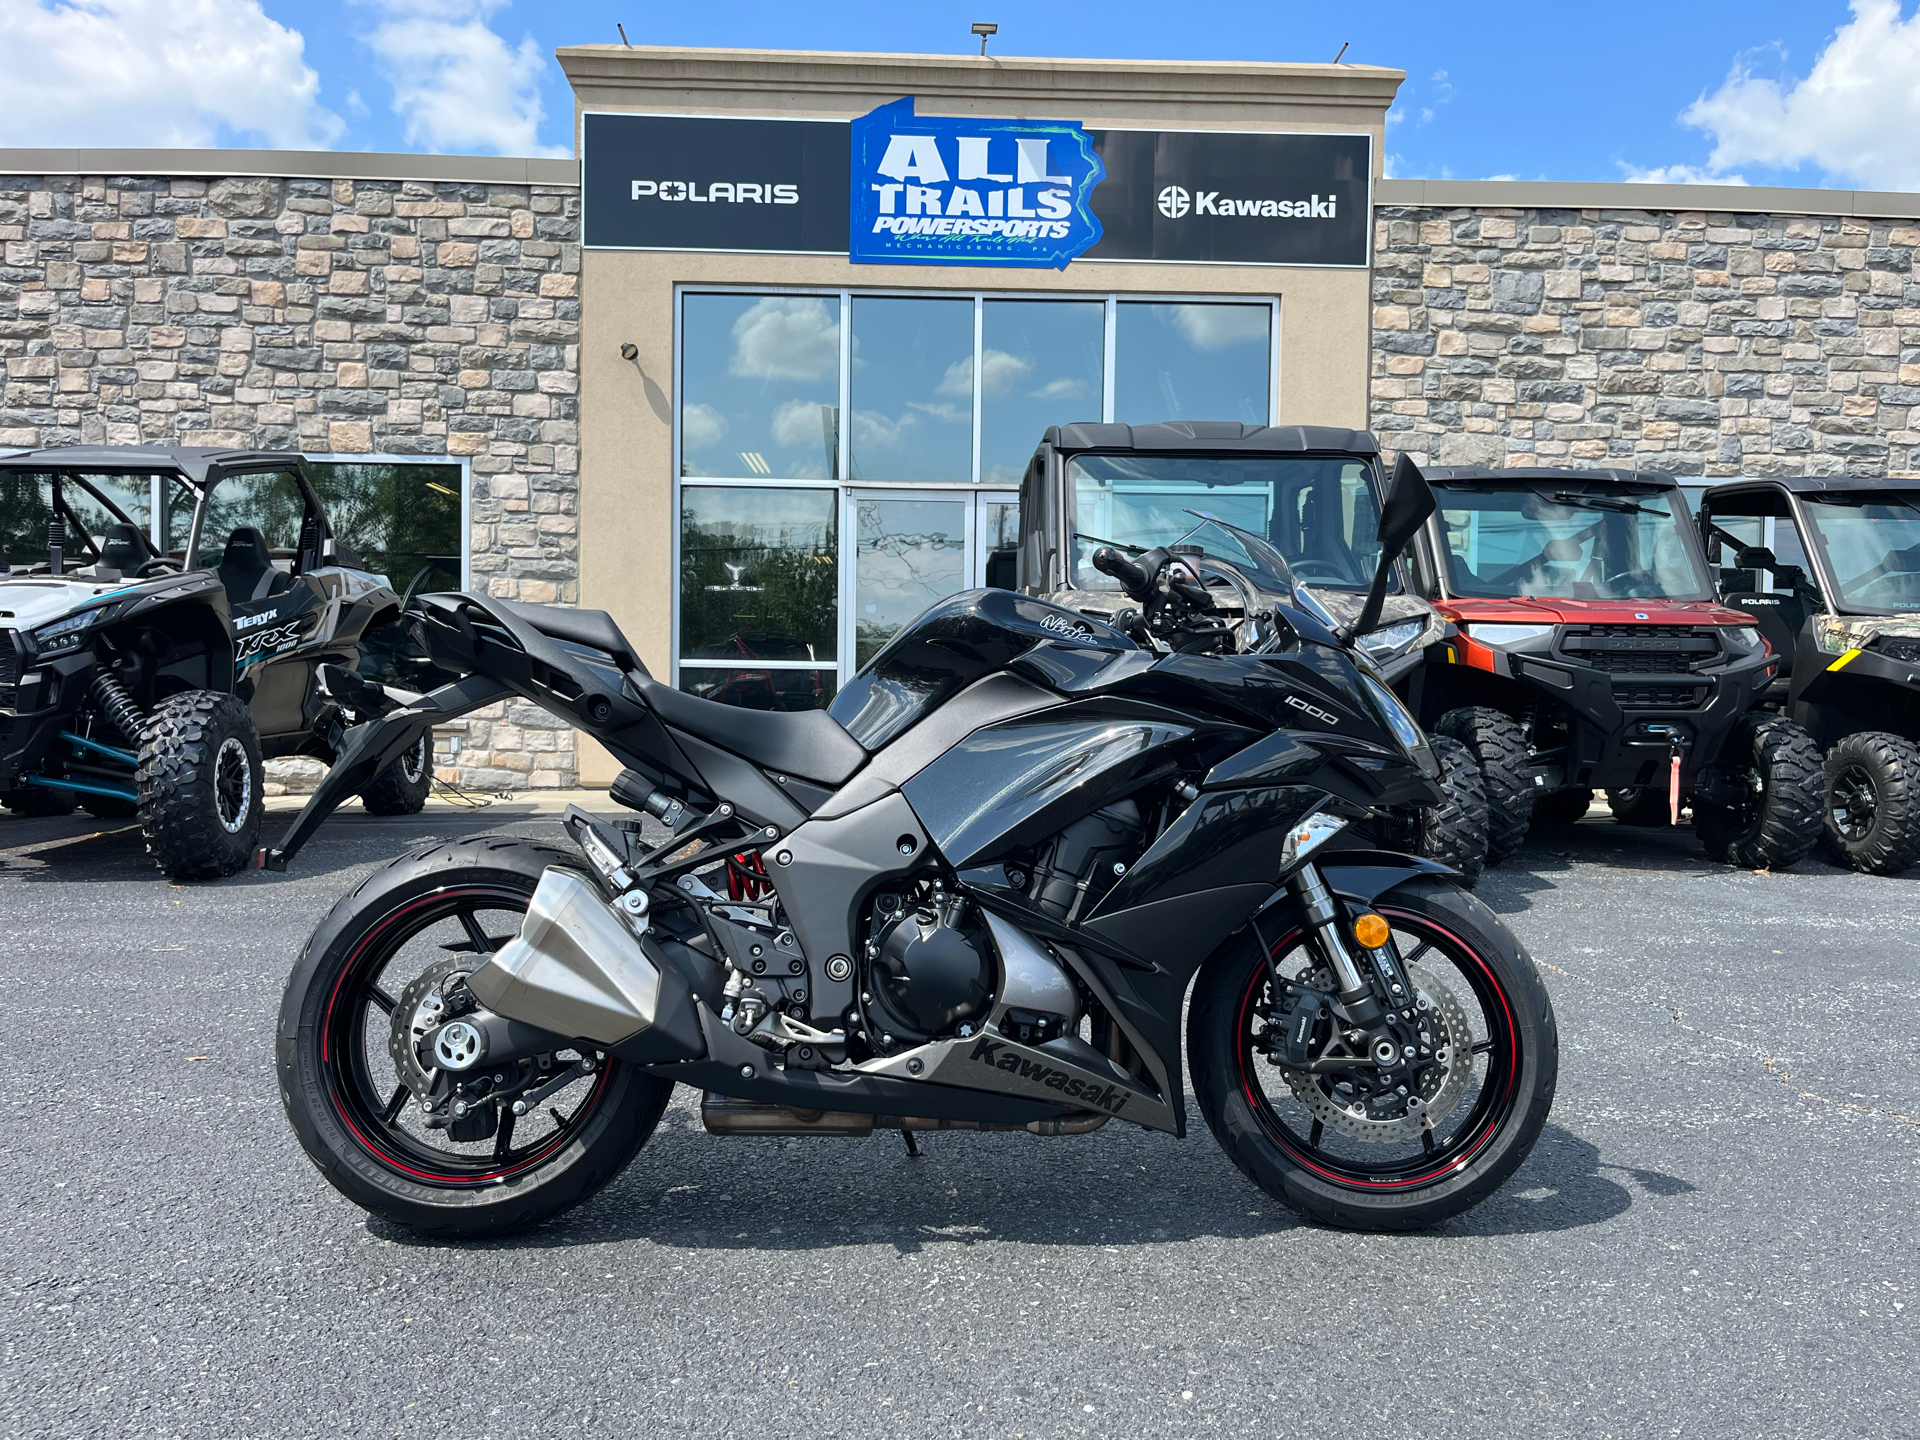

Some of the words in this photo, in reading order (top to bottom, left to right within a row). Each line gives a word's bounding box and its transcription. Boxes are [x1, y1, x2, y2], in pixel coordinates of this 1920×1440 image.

[877, 134, 1072, 187] ALL
[631, 180, 799, 205] POLARIS
[871, 182, 1072, 219] TRAILS
[1196, 191, 1337, 218] Kawasaki
[872, 216, 1071, 239] POWERSPORTS
[1040, 614, 1098, 644] Ninja
[1608, 639, 1680, 650] POLARIS
[1284, 695, 1339, 725] 1000
[1296, 1016, 1307, 1043] Kawasaki
[969, 1037, 1132, 1114] Kawasaki
[1354, 1189, 1432, 1205] MICHELIN
